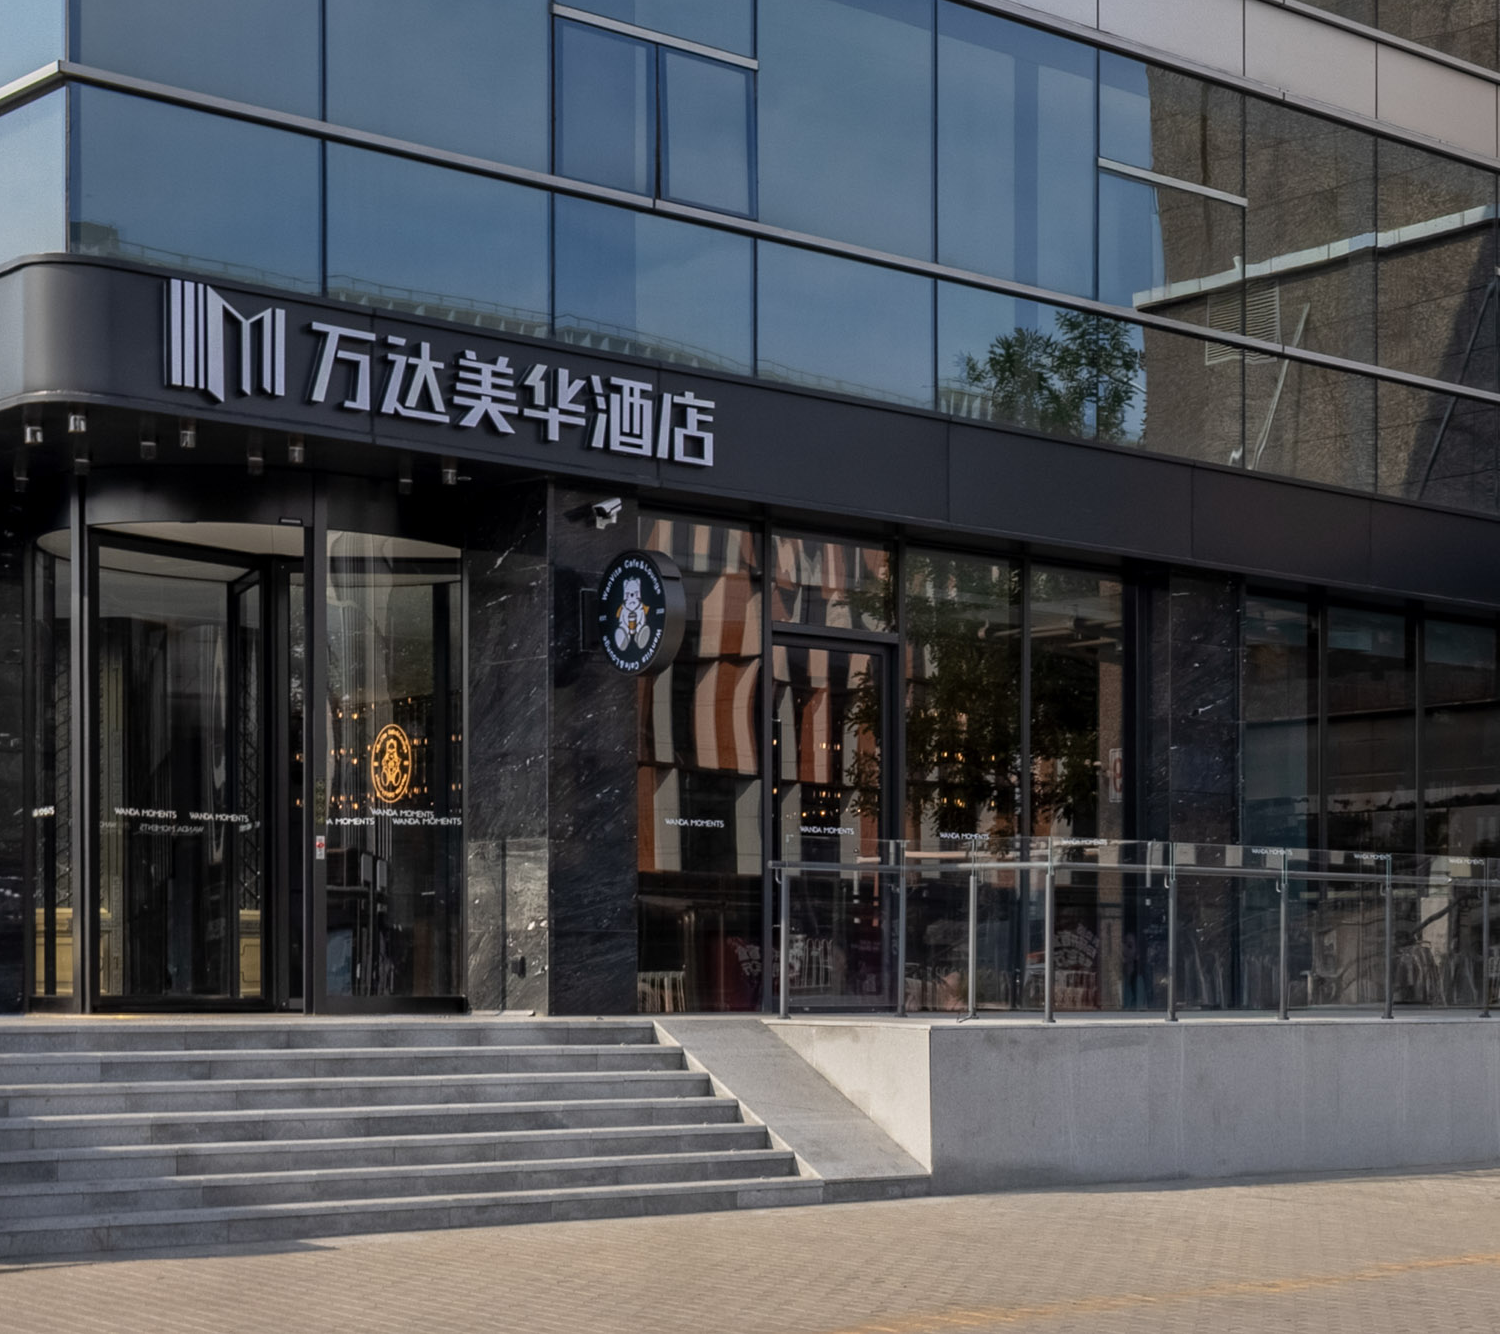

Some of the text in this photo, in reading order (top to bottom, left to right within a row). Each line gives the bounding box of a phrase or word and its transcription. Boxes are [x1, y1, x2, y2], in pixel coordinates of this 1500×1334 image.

[308, 320, 716, 467] 万达美华酒店
[114, 807, 177, 819] WANDA MOMENTS
[189, 812, 249, 823] WANDA MOMENTS
[370, 807, 435, 819] WANDA MOMENTS
[335, 817, 375, 826] MOMENTS
[393, 817, 462, 826] WANDA MOMENTS
[664, 818, 725, 828] WANDA MOMENTS
[800, 825, 855, 835] WANDA MOMENTS
